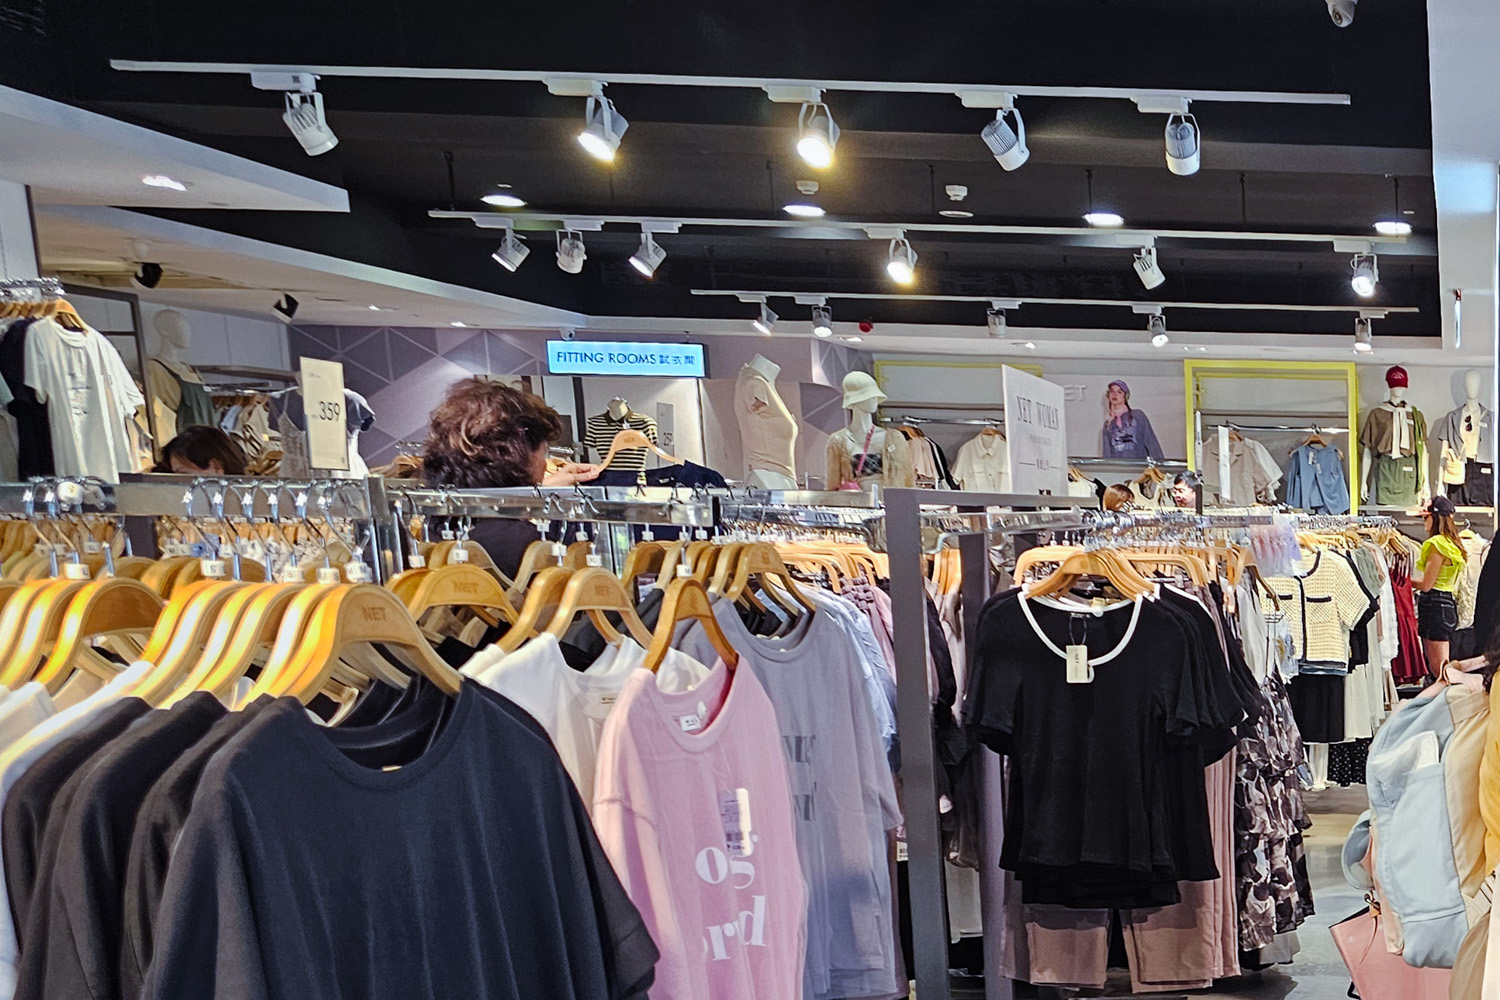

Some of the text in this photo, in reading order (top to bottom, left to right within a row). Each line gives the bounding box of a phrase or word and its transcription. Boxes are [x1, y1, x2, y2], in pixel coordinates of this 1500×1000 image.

[557, 351, 604, 363] FITTING
[609, 352, 656, 365] ROOMS
[1064, 384, 1088, 402] ET
[319, 401, 341, 422] 359
[451, 580, 479, 595] NET
[361, 605, 387, 622] NET
[702, 894, 768, 962] rd
